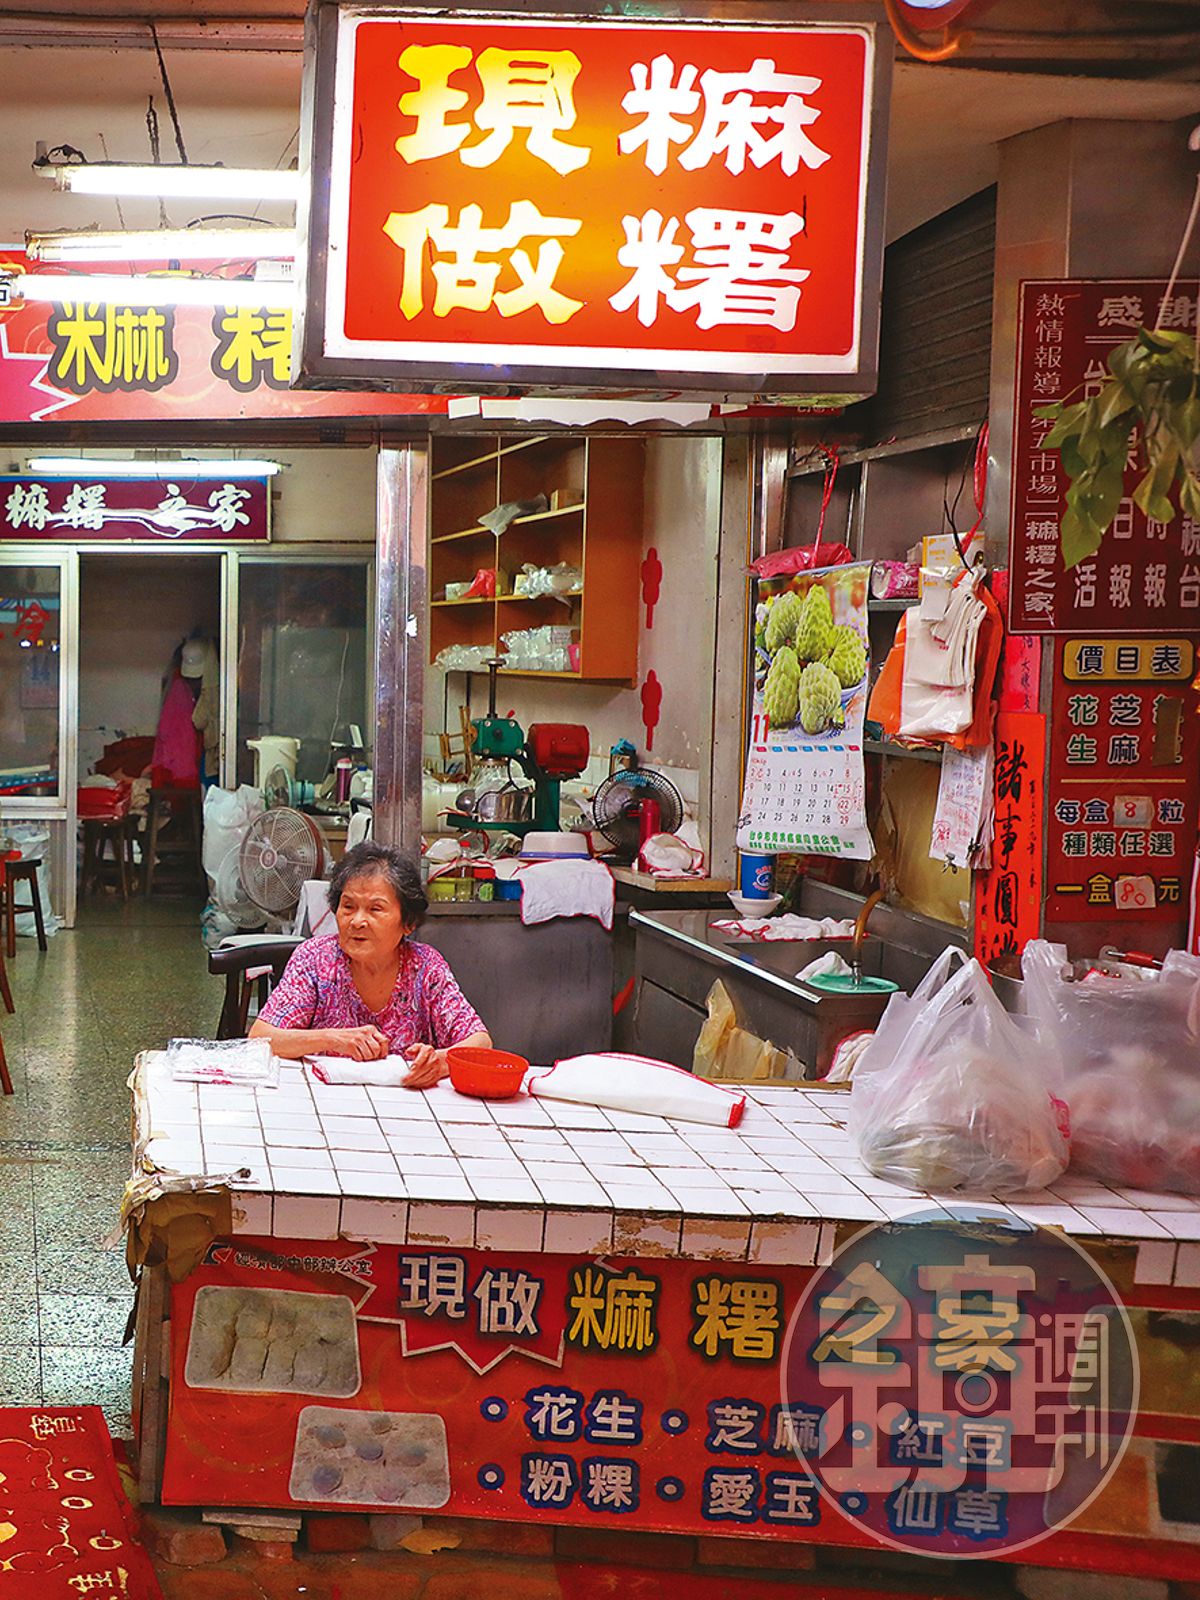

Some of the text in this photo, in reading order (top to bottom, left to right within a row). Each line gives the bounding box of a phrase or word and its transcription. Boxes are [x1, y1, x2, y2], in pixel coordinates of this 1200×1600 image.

[1076, 644, 1180, 674] 價目表
[754, 714, 770, 743] 11
[1066, 694, 1099, 764] 花生
[1107, 694, 1141, 764] 芝麻
[1063, 831, 1176, 856] 種類任選
[402, 1257, 542, 1335] 現做
[533, 1394, 642, 1440] 花生
[713, 1405, 820, 1452] 芝麻
[897, 1418, 1006, 1466] 紅豆
[527, 1459, 634, 1505] 粉粿
[709, 1474, 814, 1520] 愛玉
[894, 1486, 1001, 1534] 仙草
